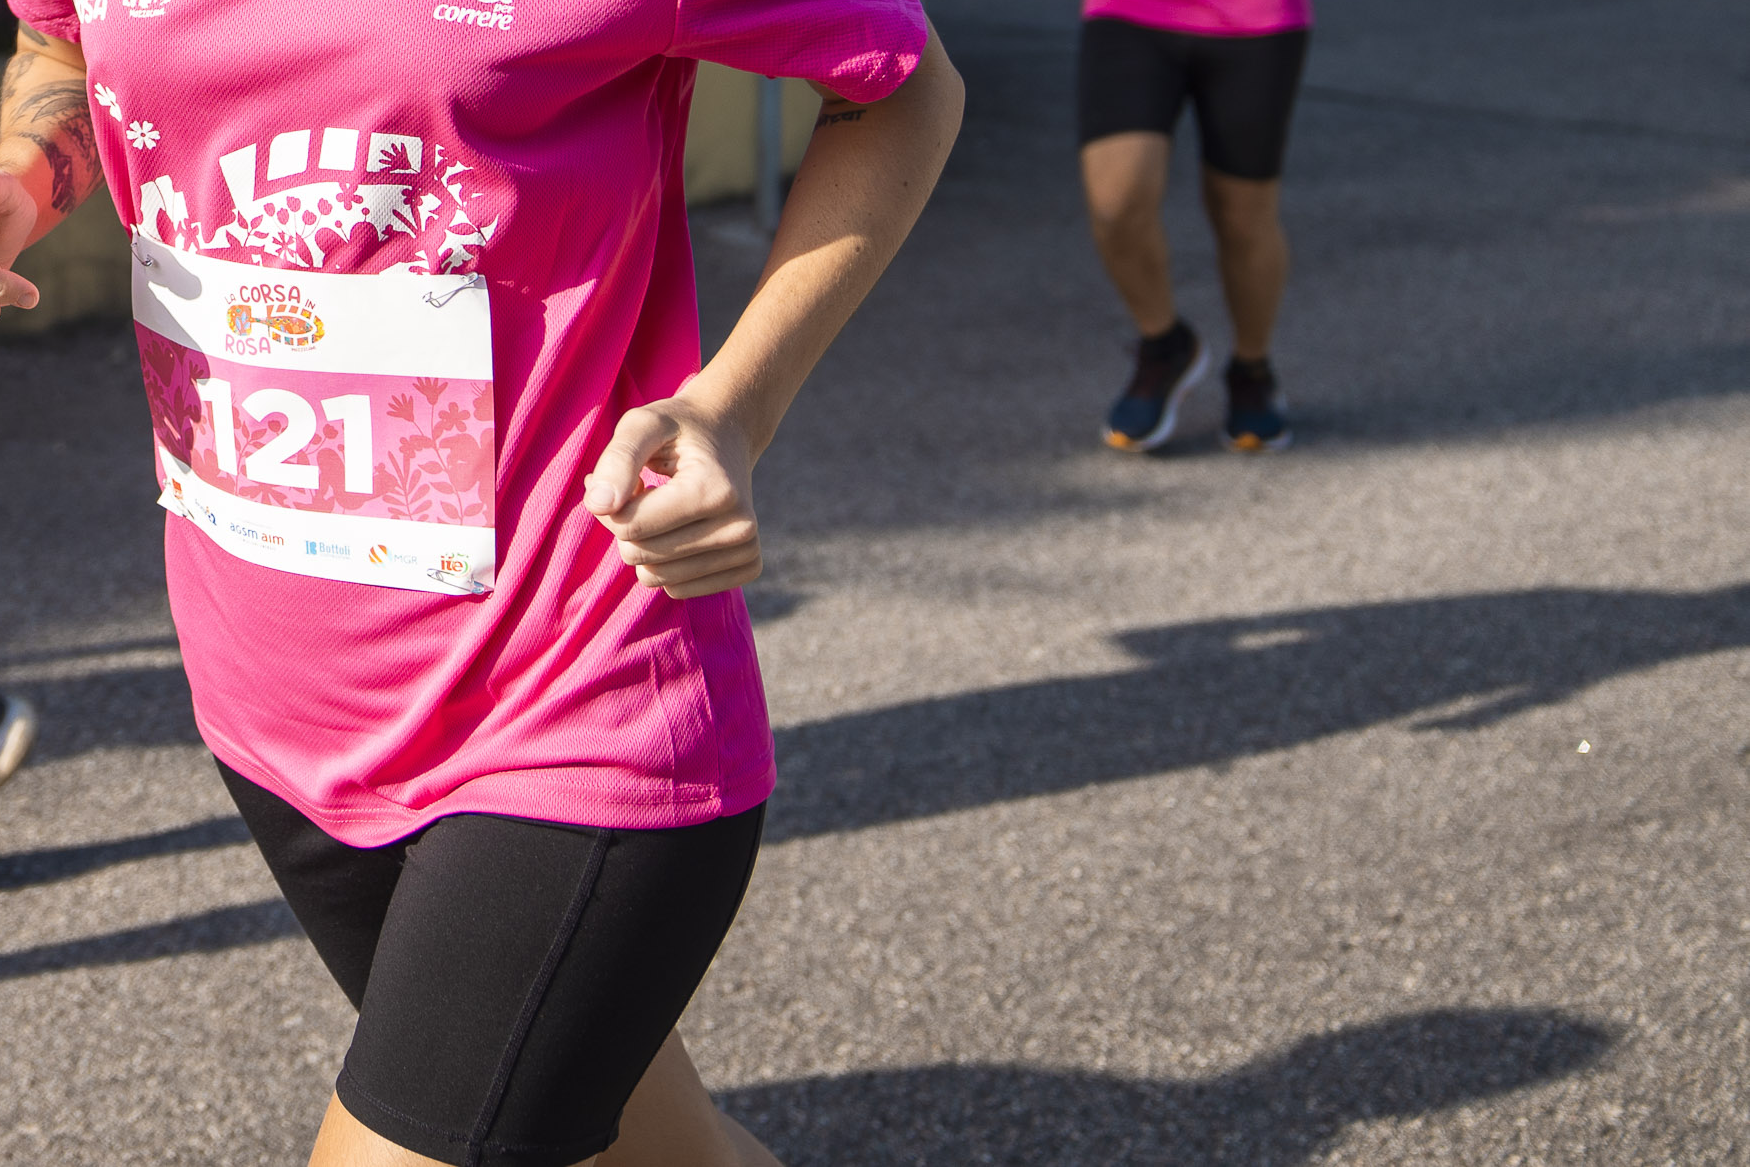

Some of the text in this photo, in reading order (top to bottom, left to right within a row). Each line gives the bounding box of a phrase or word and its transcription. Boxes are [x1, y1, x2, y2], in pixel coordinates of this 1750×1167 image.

[433, 3, 514, 31] correre
[224, 283, 316, 310] LA CORSA IN
[225, 333, 272, 356] ROSA
[196, 377, 374, 495] 121
